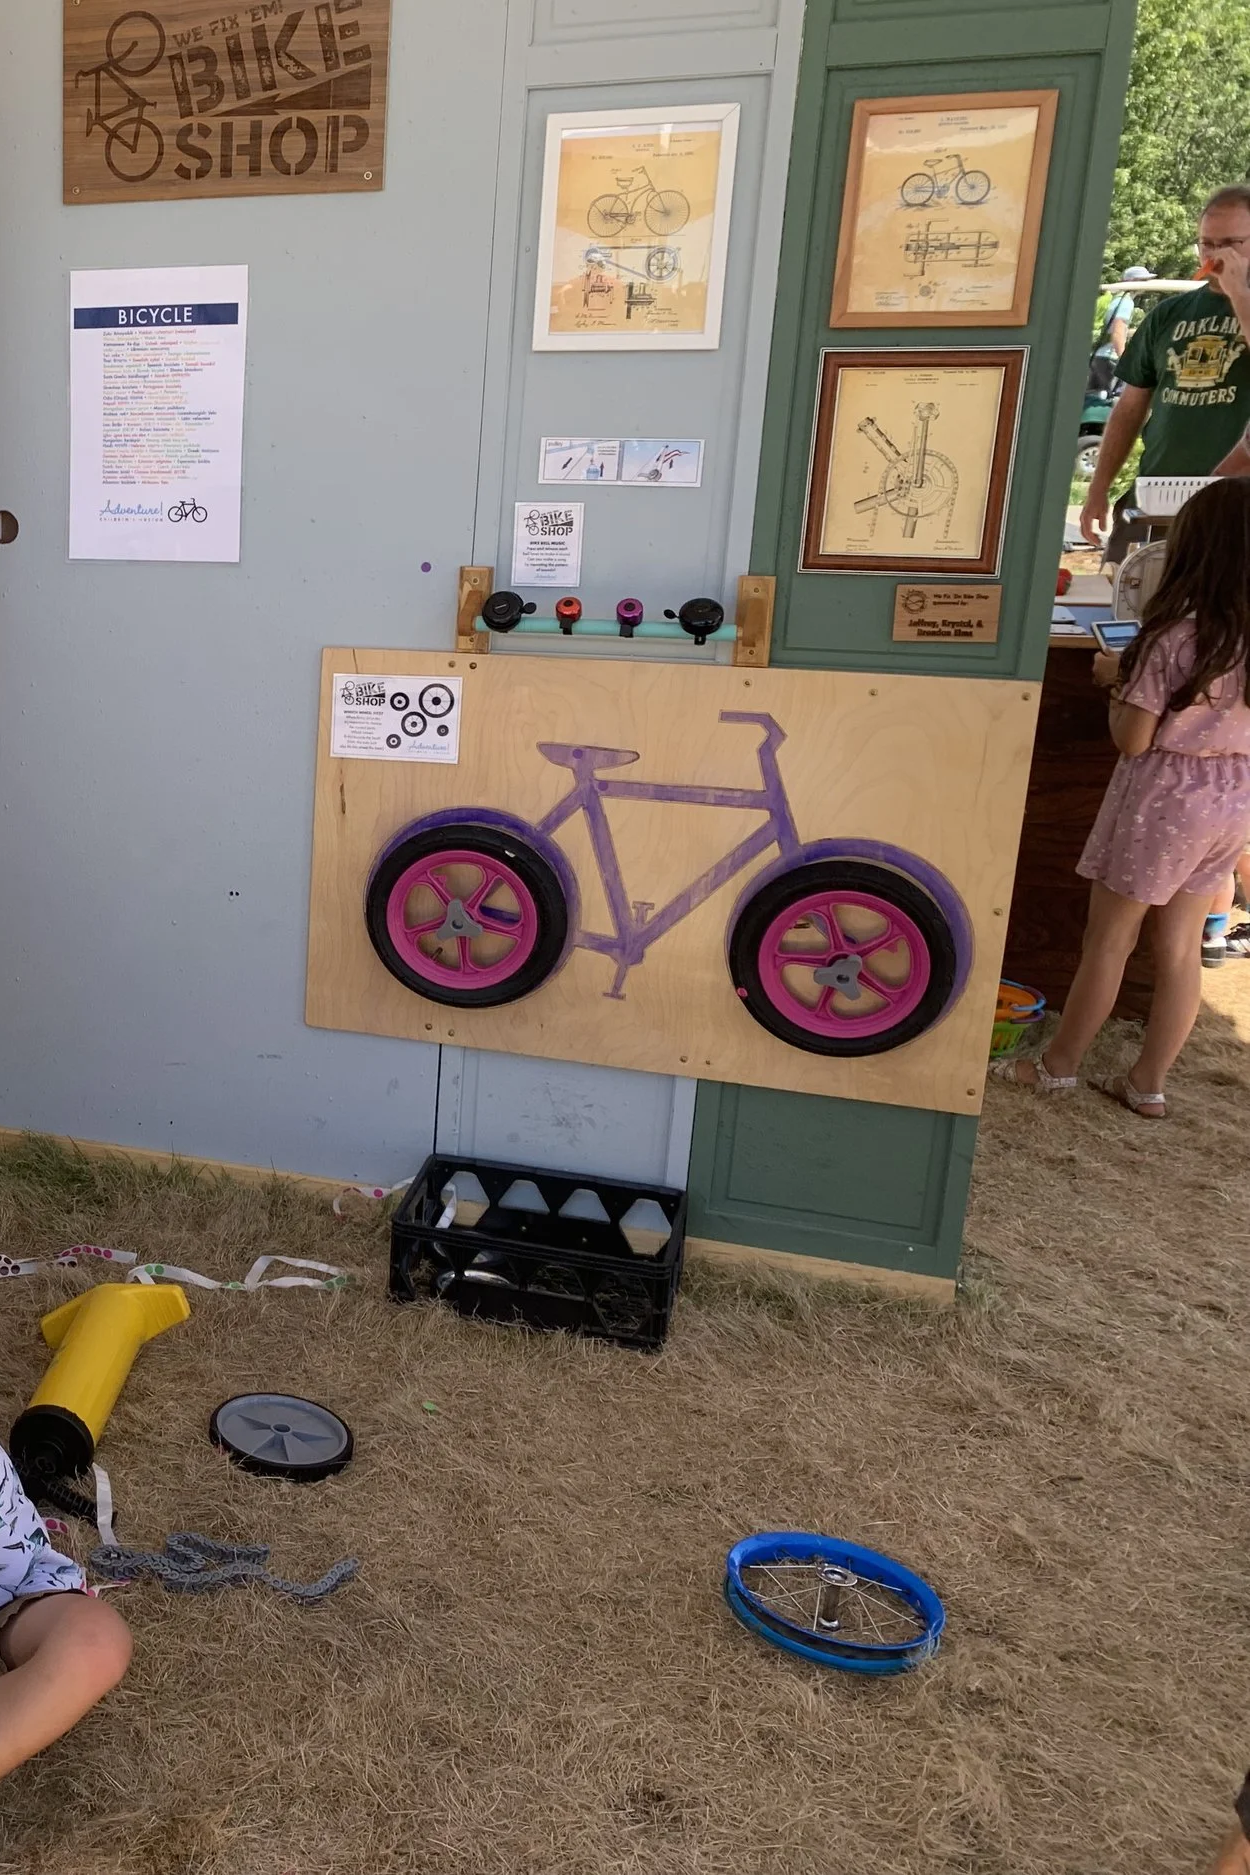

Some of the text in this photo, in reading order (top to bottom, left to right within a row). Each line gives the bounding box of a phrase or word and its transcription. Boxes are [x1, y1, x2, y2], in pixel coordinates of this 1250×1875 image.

[172, 26, 203, 48] WE
[209, 15, 240, 37] FIX
[167, 0, 372, 119] BIKE
[173, 115, 370, 181] SHOP
[118, 307, 192, 325] BICYCLE
[1172, 315, 1241, 341] OAKLAN
[1162, 386, 1237, 406] COMMUTERS
[99, 499, 163, 516] Adventure!
[540, 511, 574, 527] BIKE
[540, 527, 573, 536] SHOP
[908, 618, 939, 629] Jeffrey,
[976, 620, 984, 628] &
[355, 683, 386, 697] BIKE
[355, 697, 386, 707] SHOP
